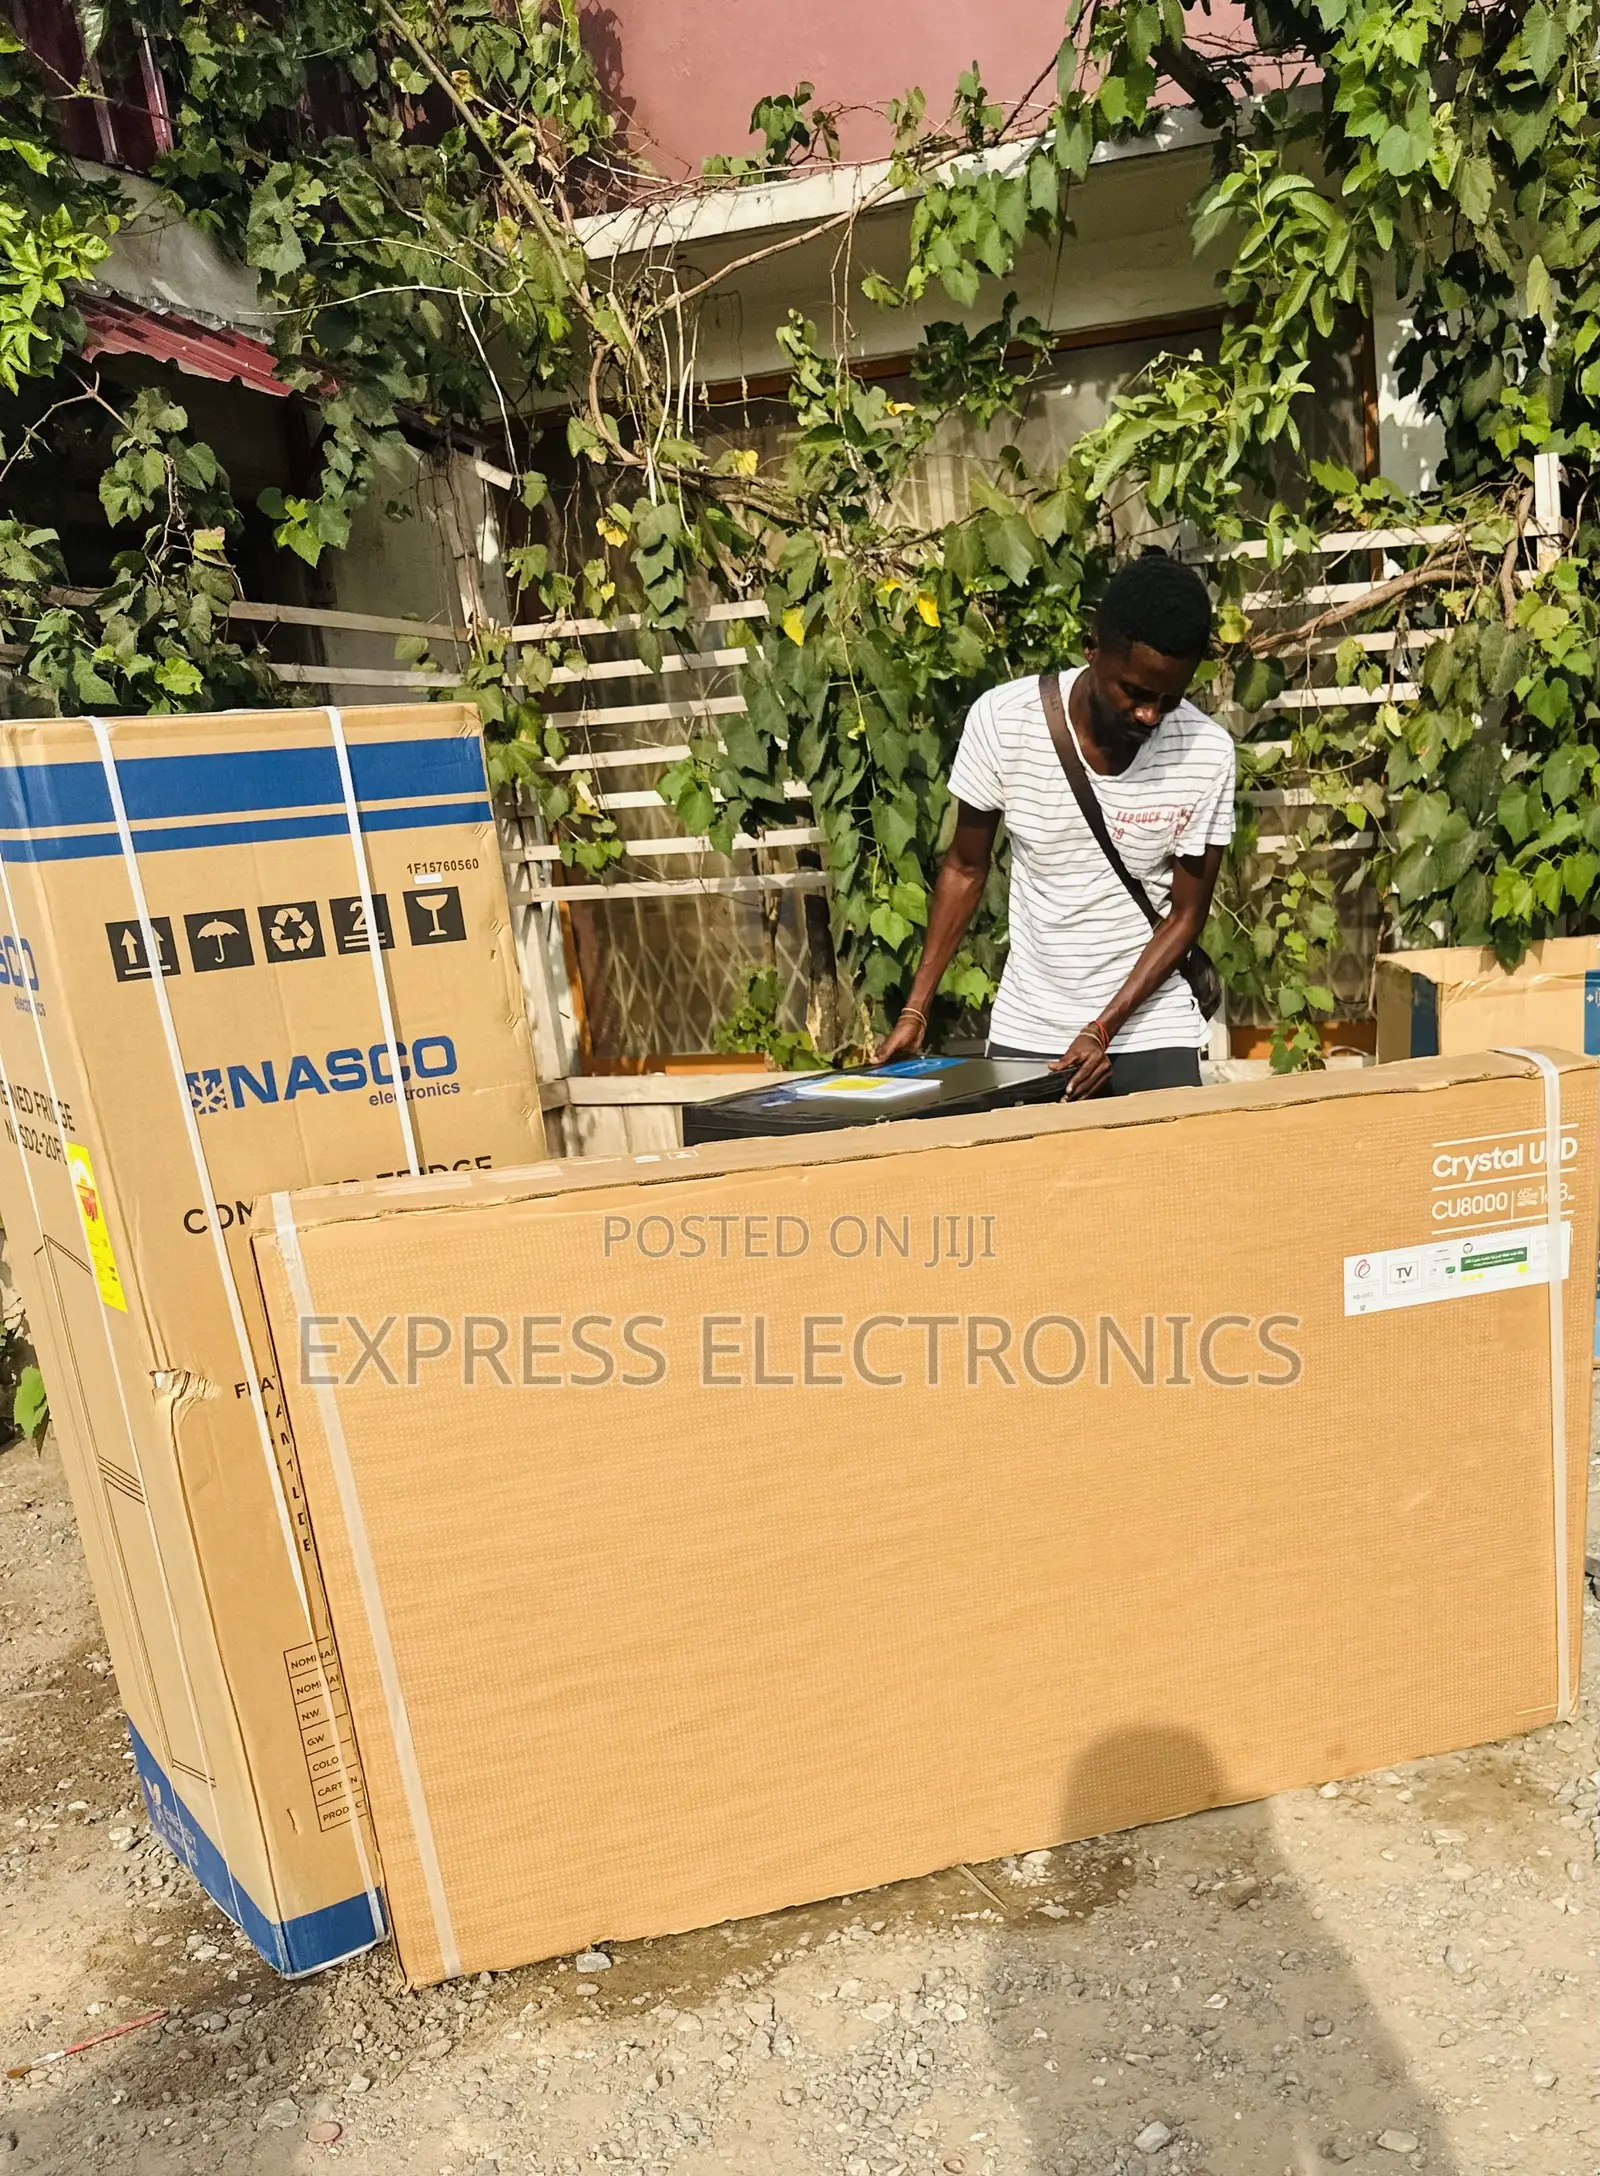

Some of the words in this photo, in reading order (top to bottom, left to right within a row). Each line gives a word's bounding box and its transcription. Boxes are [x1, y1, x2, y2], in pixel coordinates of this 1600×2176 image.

[406, 858, 479, 875] 1F15760560
[226, 1035, 458, 1109] NASCO
[368, 1081, 461, 1106] eletronics
[1432, 1143, 1524, 1181] Crystal
[1529, 1137, 1578, 1165] UD
[1431, 1192, 1508, 1220] CU8000
[1396, 1266, 1413, 1279] TV
[317, 1776, 358, 1796] CARTN
